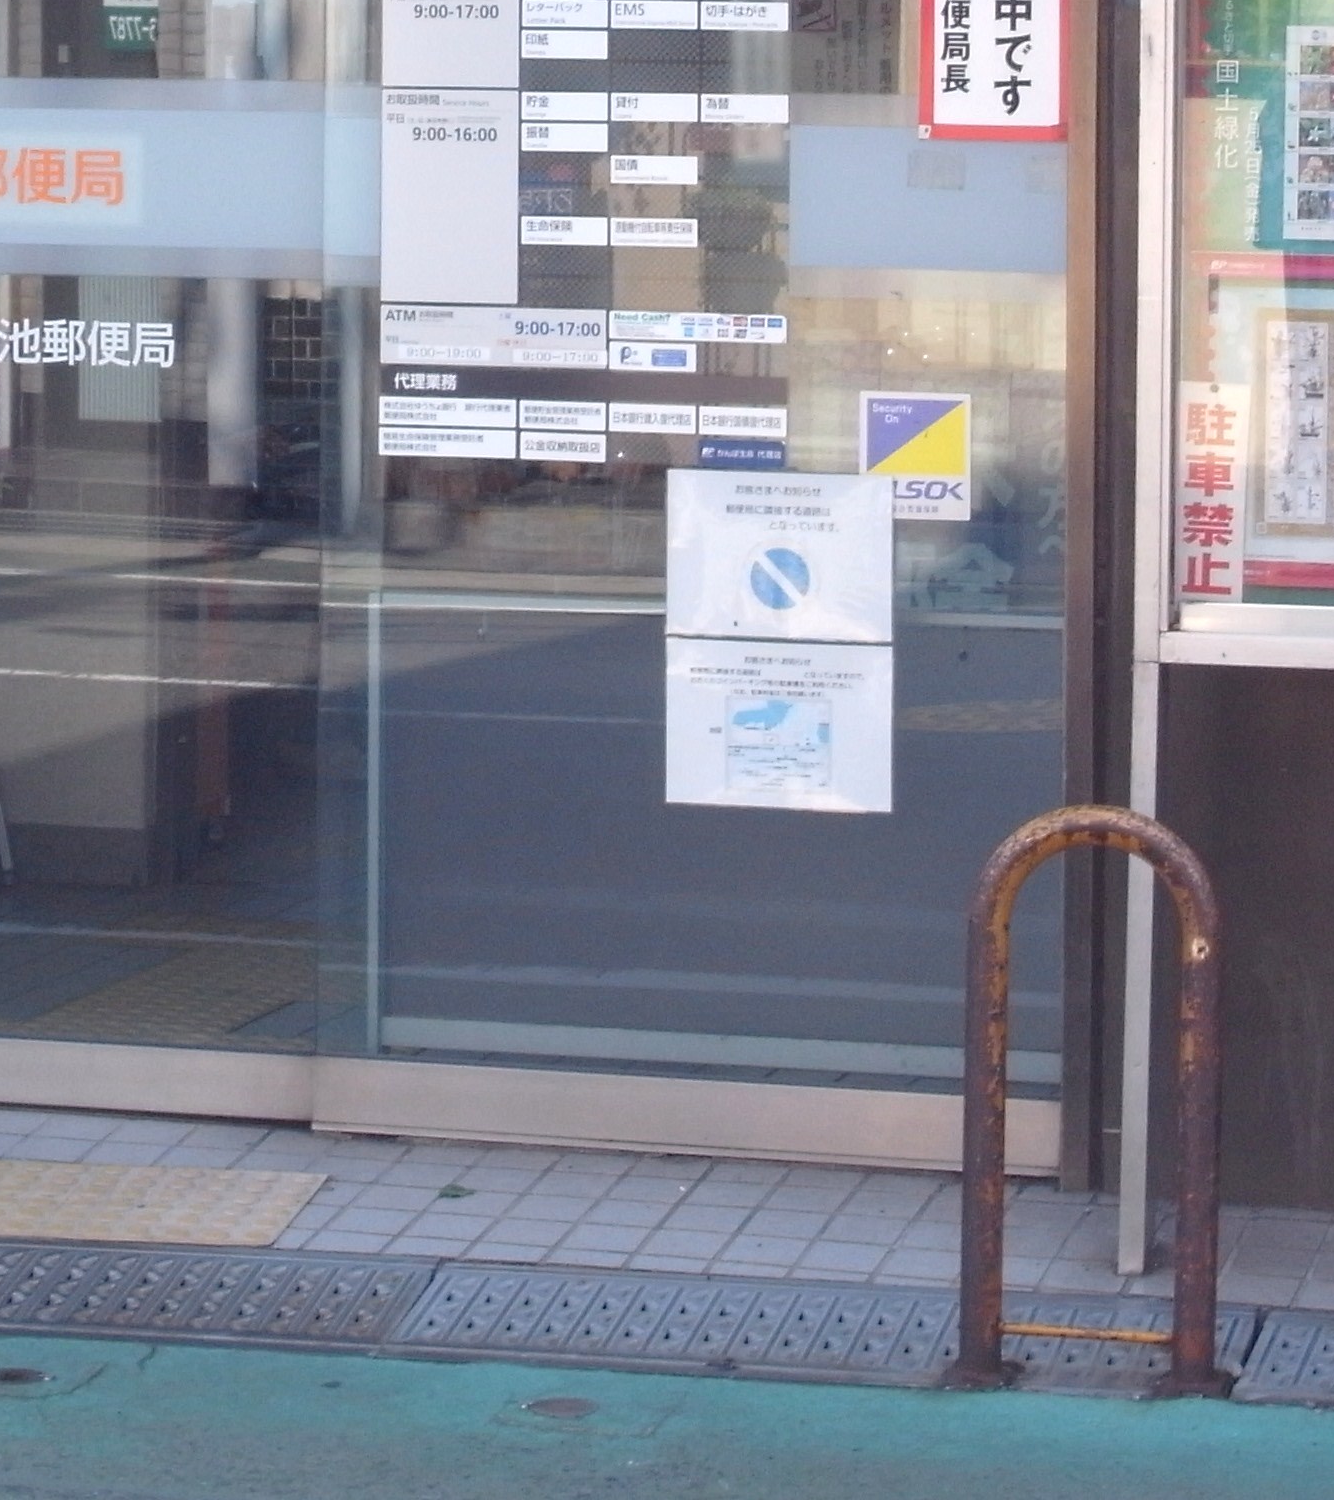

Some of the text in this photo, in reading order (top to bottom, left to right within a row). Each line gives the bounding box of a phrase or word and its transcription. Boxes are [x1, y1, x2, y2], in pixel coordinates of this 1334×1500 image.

[414, 4, 499, 19] 9:00-17:00
[615, 4, 645, 16] EMS
[705, 5, 767, 17] 切手・はがき
[525, 33, 549, 46] 印紙
[526, 95, 549, 108] 貯金
[616, 97, 639, 109] 貸付
[706, 97, 730, 110] 為替
[1214, 59, 1239, 169] 国土緑化
[412, 127, 498, 141] 9:00-16:00
[526, 127, 549, 139] 振替
[615, 159, 638, 171] 国債
[385, 310, 416, 321] ATM
[614, 313, 638, 321] Need
[515, 321, 601, 336] 9:00-17:00
[394, 373, 457, 390] 代理業務
[872, 403, 913, 414] Security
[885, 415, 899, 423] On
[892, 480, 963, 500] LSOK
[1181, 402, 1237, 595] 駐車禁止
